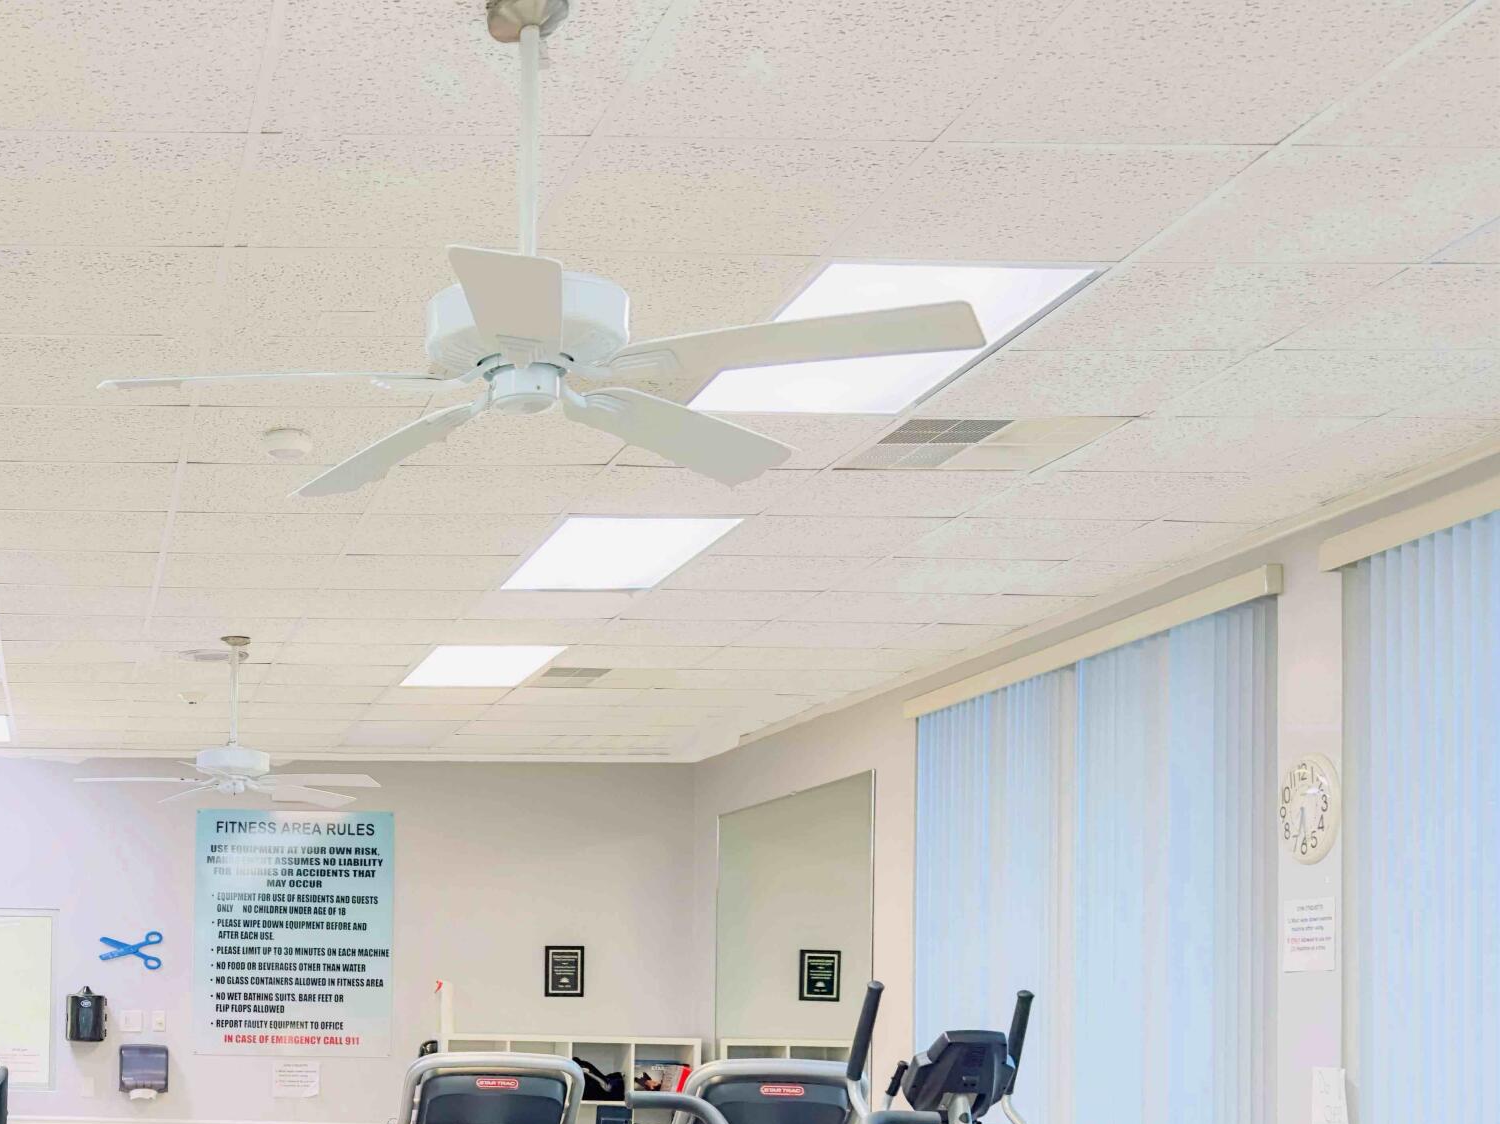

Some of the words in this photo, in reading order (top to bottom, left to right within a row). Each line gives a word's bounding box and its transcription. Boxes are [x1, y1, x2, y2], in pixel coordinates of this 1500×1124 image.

[1321, 794, 1328, 812] 3
[1280, 806, 1287, 823] 9
[216, 821, 277, 835] FITNESS
[282, 822, 322, 836] AREA
[327, 823, 375, 836] RULES
[1318, 814, 1325, 831] 4
[1284, 822, 1291, 840] 8
[1311, 831, 1318, 848] 5
[211, 844, 228, 853] USE
[287, 846, 298, 854] AT
[301, 846, 326, 855] YOUR
[329, 846, 352, 855] OWN
[1301, 837, 1307, 855] 6
[275, 857, 320, 866] ASSUMES
[323, 857, 336, 866] NO
[338, 858, 383, 867] LIABILITY
[281, 868, 294, 877] OR
[296, 868, 350, 878] ACCIDENTS
[352, 869, 376, 878] THAT
[266, 879, 286, 888] MAY
[289, 879, 322, 888] OCCUR
[217, 892, 256, 901] EQUIPMENT
[258, 893, 271, 901] FOR
[272, 893, 285, 902] USE
[287, 893, 295, 902] OF
[297, 894, 334, 903] RESIDENTS
[336, 895, 350, 904] AND
[351, 896, 378, 904] GUESTS
[217, 903, 233, 912] ONLY
[243, 904, 252, 913] NO
[254, 905, 287, 914] CHILDREN
[289, 906, 312, 915] UNDER
[313, 906, 326, 915] AGE
[328, 907, 336, 915] OF
[217, 918, 241, 928] PLEASE
[243, 919, 260, 928] WIPE
[262, 920, 283, 929] DOWN
[285, 920, 324, 930] EQUIPMENT
[326, 921, 351, 931] BEFORE
[352, 922, 367, 931] AND
[218, 930, 239, 939] AFTER
[240, 931, 258, 940] EACH
[216, 945, 241, 955] PLEASE
[242, 946, 261, 955] LIMIT
[262, 946, 272, 955] UP
[273, 947, 282, 955] TO
[283, 947, 293, 955] 30
[294, 947, 325, 956] MINUTES
[327, 947, 336, 956] ON
[338, 948, 356, 957] EACH
[357, 948, 390, 958] MACHINE
[216, 961, 226, 970] NO
[227, 961, 245, 970] FOOD
[247, 962, 256, 971] OR
[258, 962, 297, 971] BEVERAGES
[298, 963, 320, 972] OTHER
[322, 963, 340, 972] THAN
[342, 963, 366, 972] WATER
[215, 976, 225, 985] NO
[227, 976, 249, 985] GLASS
[250, 976, 293, 986] CONTAINERS
[295, 977, 326, 986] ALLOWED
[328, 978, 335, 986] IN
[337, 978, 365, 987] FITNESS
[365, 979, 384, 988] AREA
[215, 992, 225, 1000] NO
[227, 992, 241, 1000] WET
[243, 992, 273, 1001] BATHING
[298, 993, 316, 1002] BARE
[317, 993, 332, 1002] FEET
[334, 994, 344, 1003] OR
[215, 1003, 230, 1012] FLIP
[231, 1004, 252, 1013] FLOPS
[253, 1004, 285, 1013] ALLOWED
[216, 1019, 242, 1028] REPORT
[244, 1020, 268, 1029] FAULTY
[269, 1020, 308, 1029] EQUIPMENT
[310, 1021, 319, 1030] TO
[320, 1021, 344, 1030] OFFICE
[224, 1034, 233, 1043] IN
[235, 1034, 256, 1043] CASE
[259, 1035, 269, 1044] OF
[271, 1035, 321, 1045] EMERGENCY
[323, 1036, 343, 1045] CALL
[345, 1036, 360, 1045] 911
